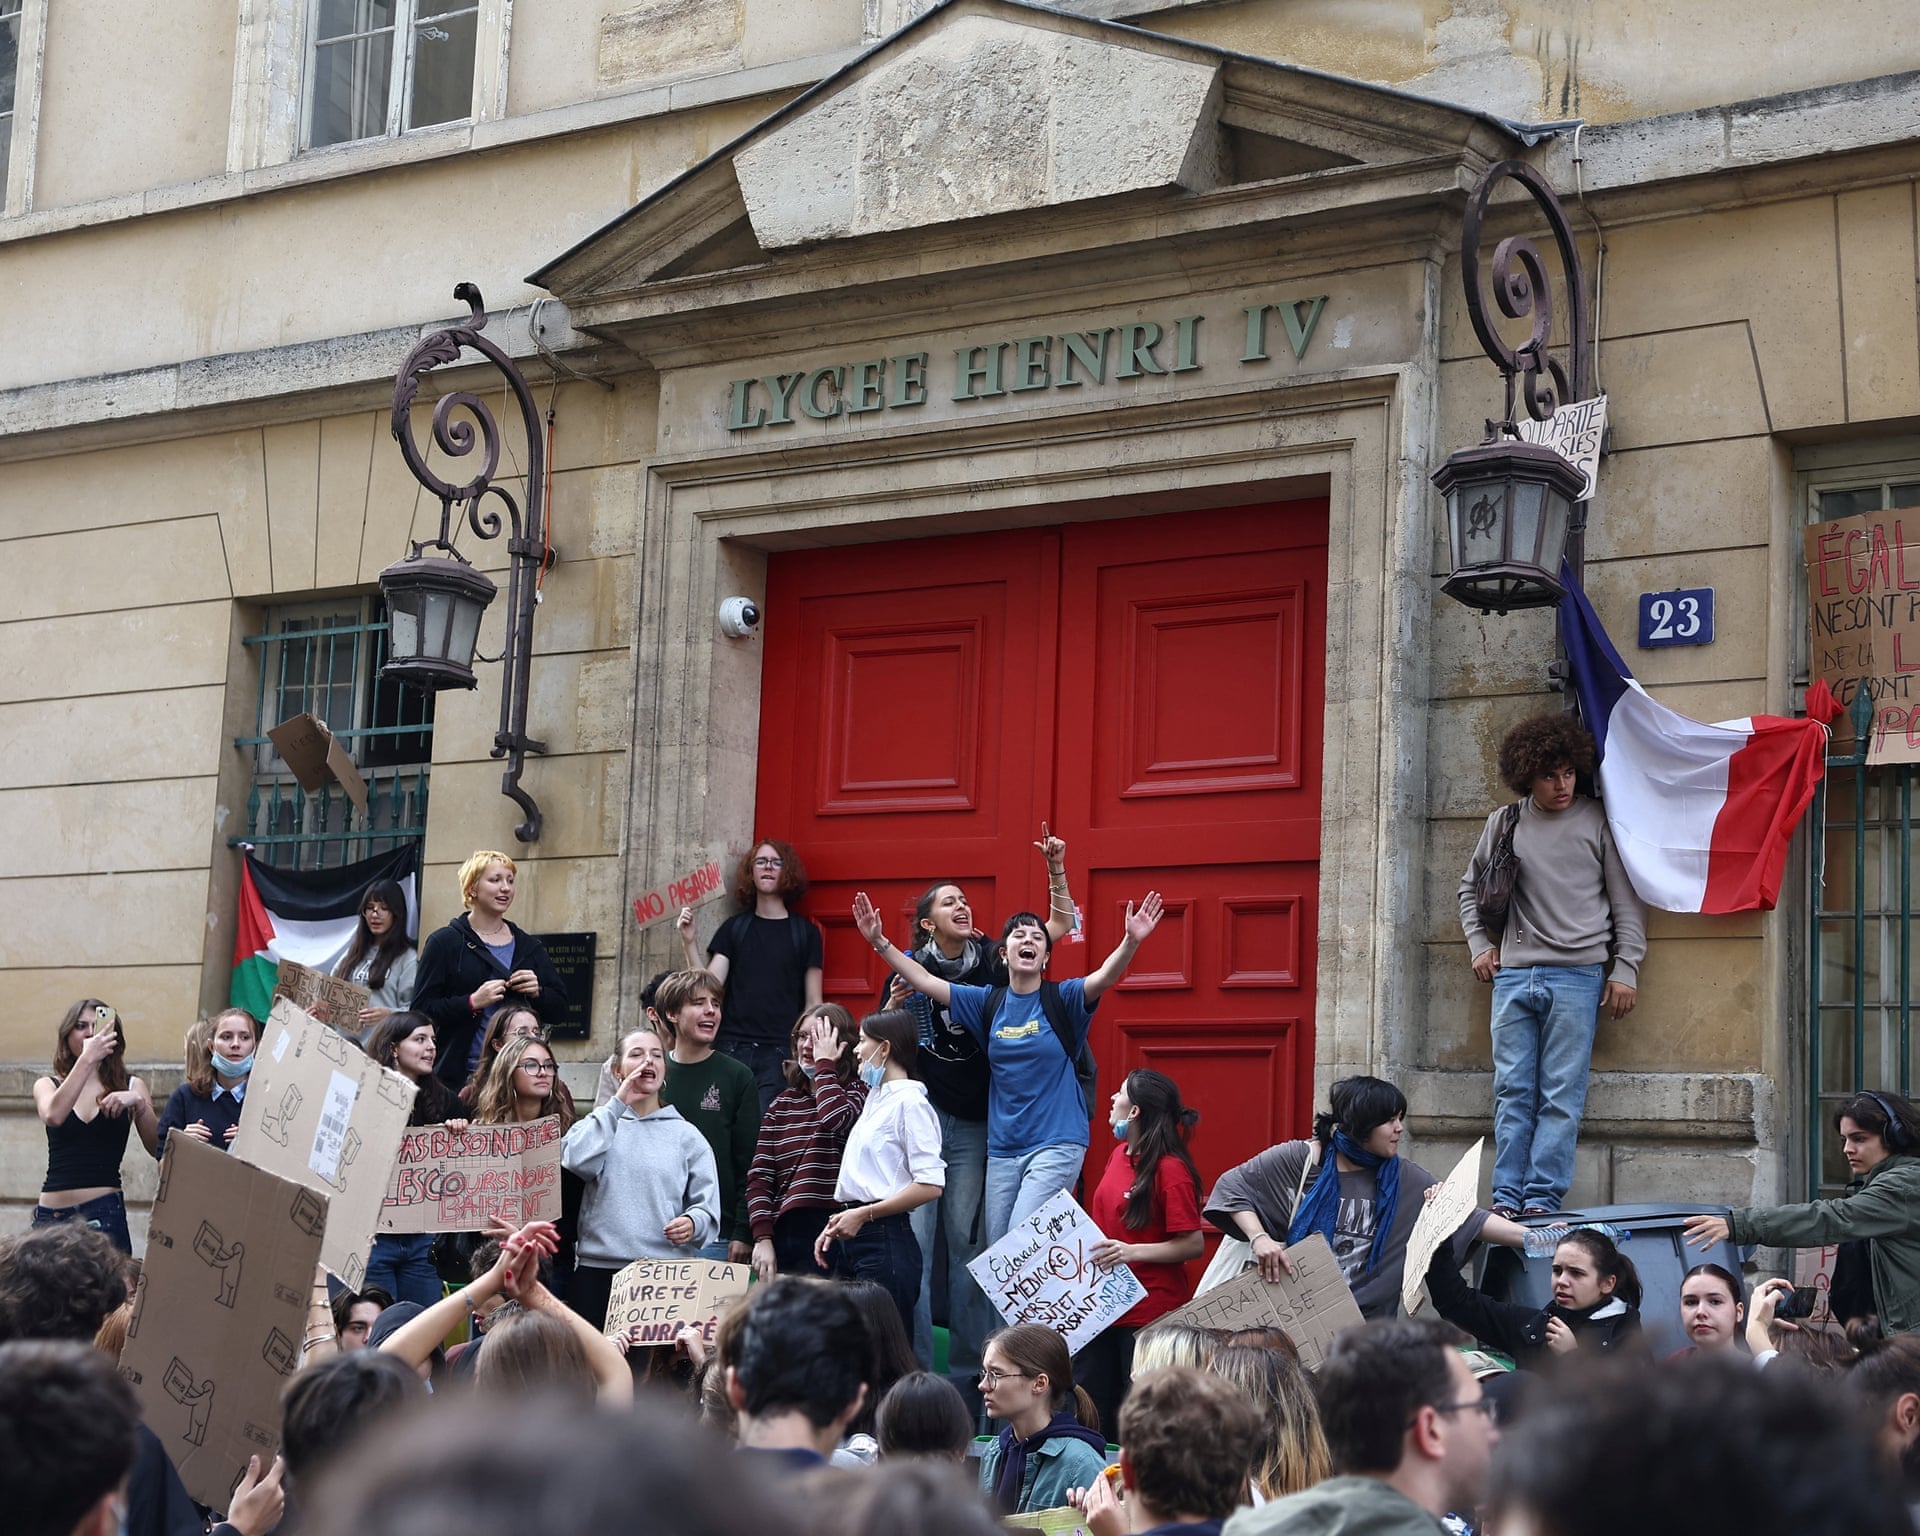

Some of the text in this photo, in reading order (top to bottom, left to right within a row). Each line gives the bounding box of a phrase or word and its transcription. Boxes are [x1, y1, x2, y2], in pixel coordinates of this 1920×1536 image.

[728, 295, 1330, 431] LYCEE HENRI IV
[1649, 597, 1700, 640] 23
[708, 1265, 736, 1282] LA
